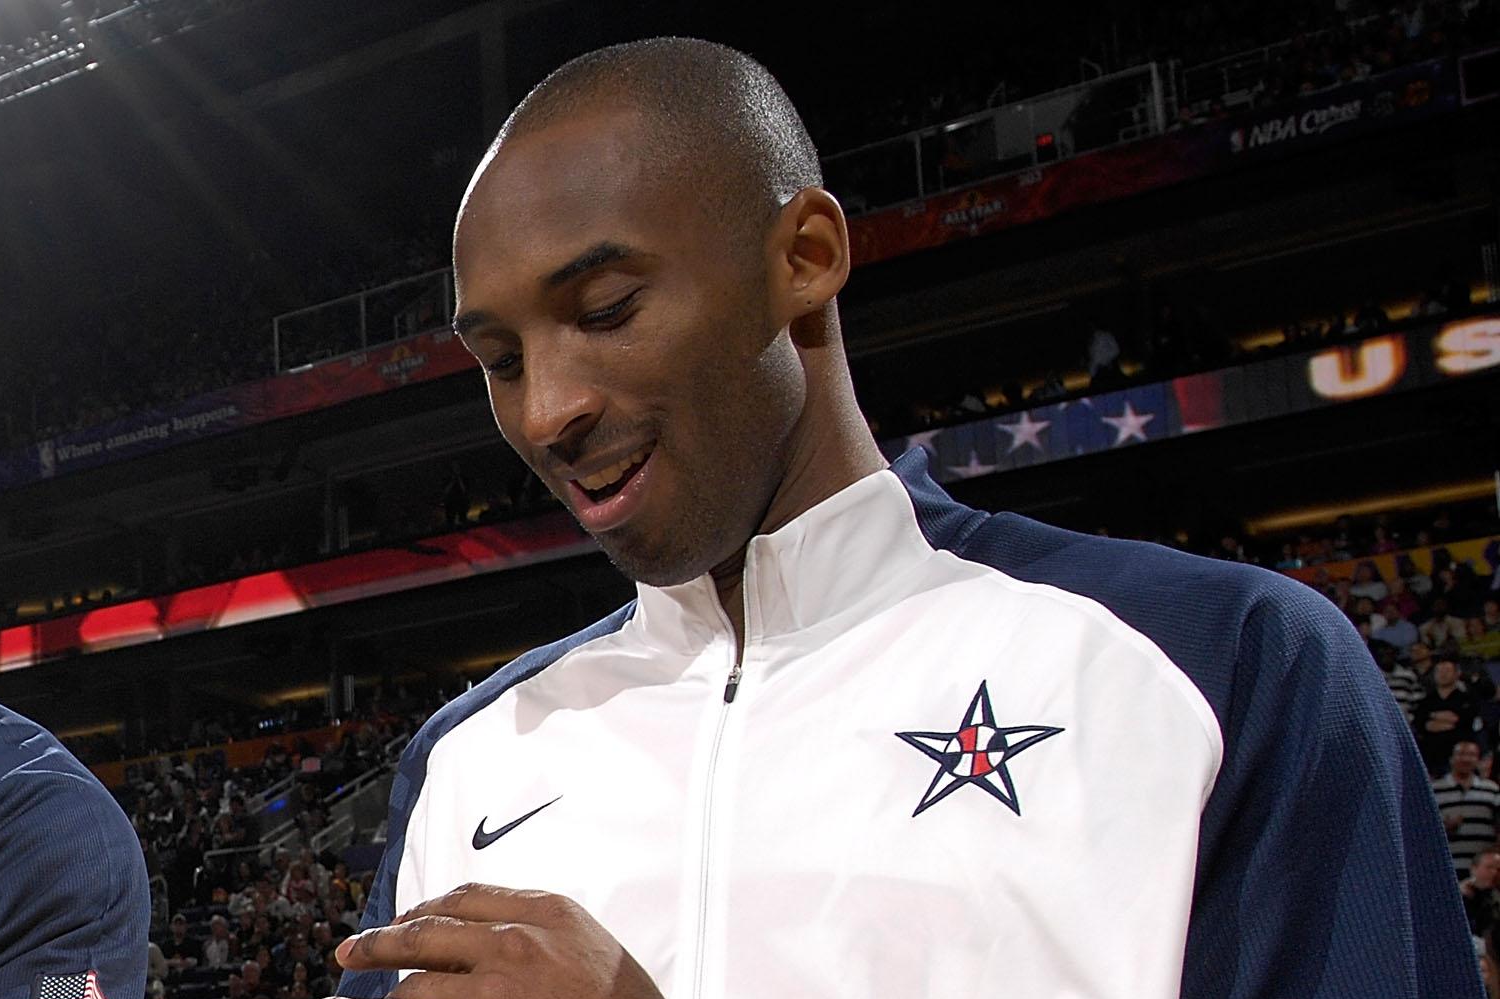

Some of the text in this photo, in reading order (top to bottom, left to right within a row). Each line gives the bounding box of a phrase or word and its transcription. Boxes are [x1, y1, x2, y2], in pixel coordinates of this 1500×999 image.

[1249, 114, 1298, 148] NBA
[56, 442, 102, 463] Where
[106, 423, 170, 450] amazing
